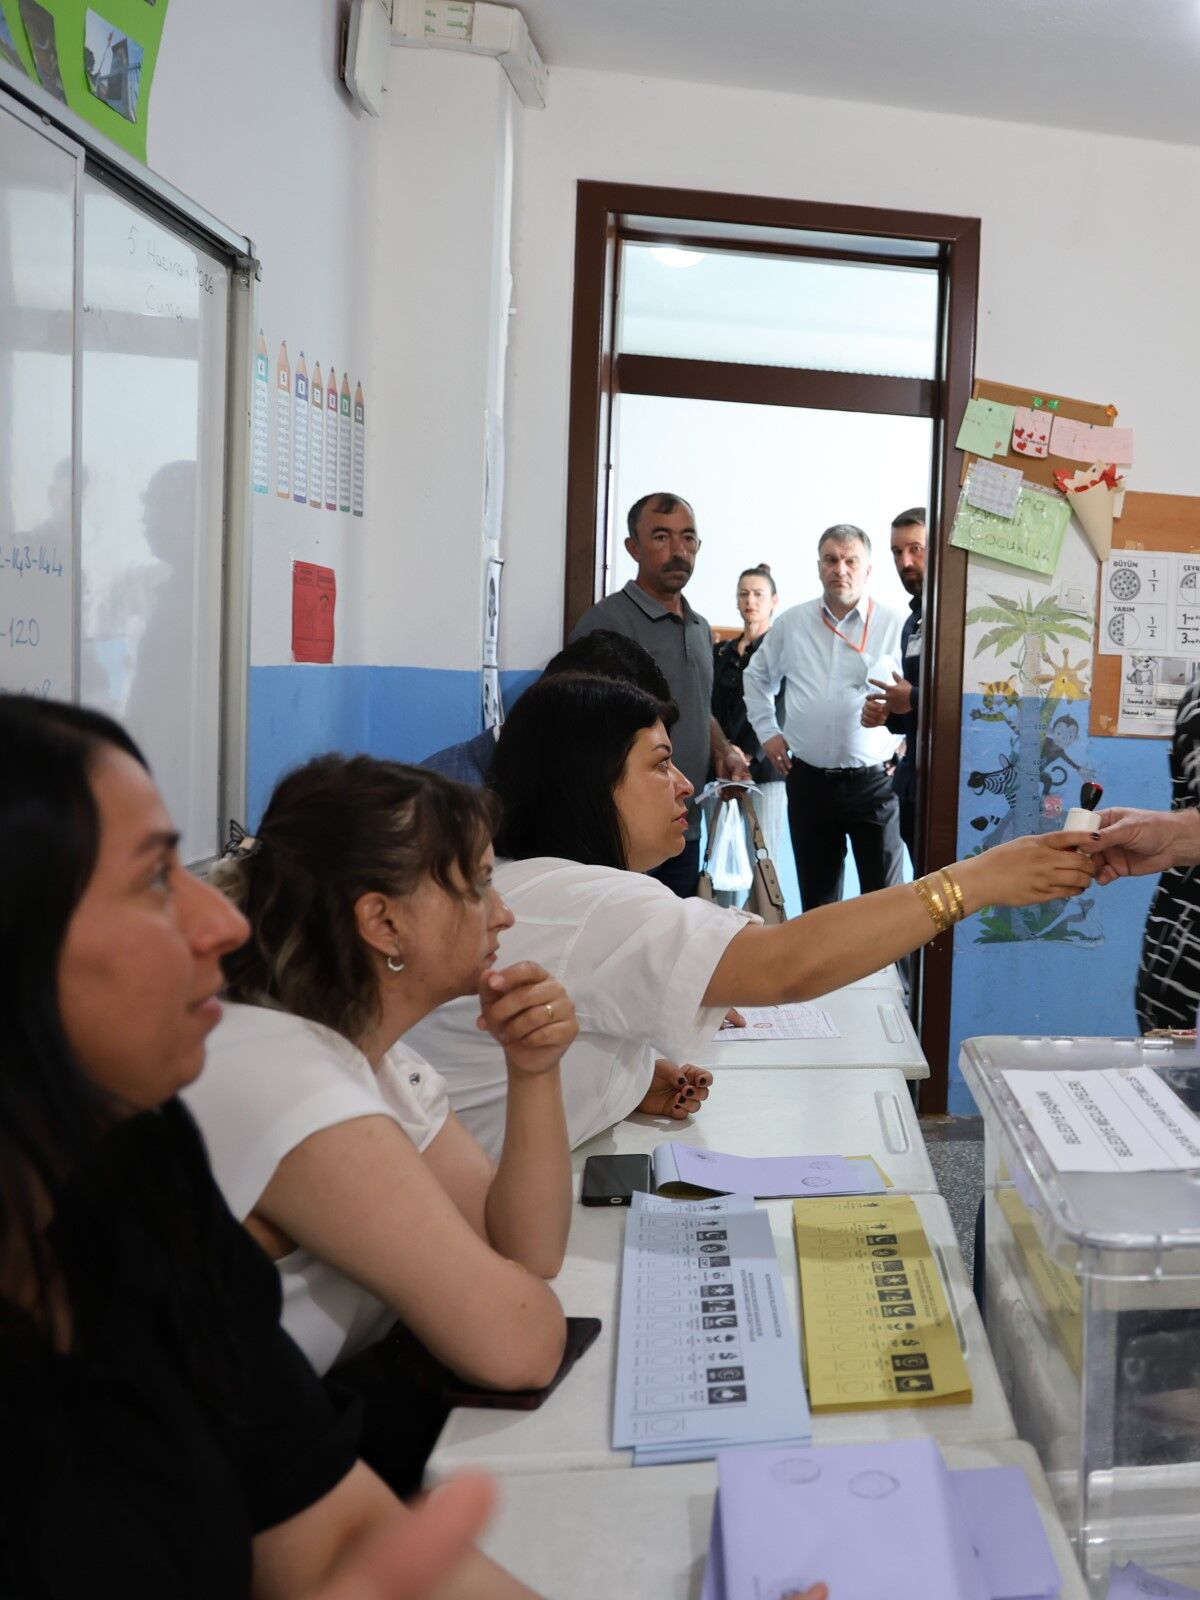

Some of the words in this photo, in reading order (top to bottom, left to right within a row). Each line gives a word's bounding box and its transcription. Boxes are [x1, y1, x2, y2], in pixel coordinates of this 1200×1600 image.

[1113, 560, 1138, 568] BÜTÜN
[1151, 569, 1157, 578] 1
[1151, 583, 1156, 592] 1
[1150, 616, 1155, 625] 1
[1182, 613, 1188, 625] 1
[1150, 629, 1156, 638] 2
[1181, 632, 1188, 644] 3
